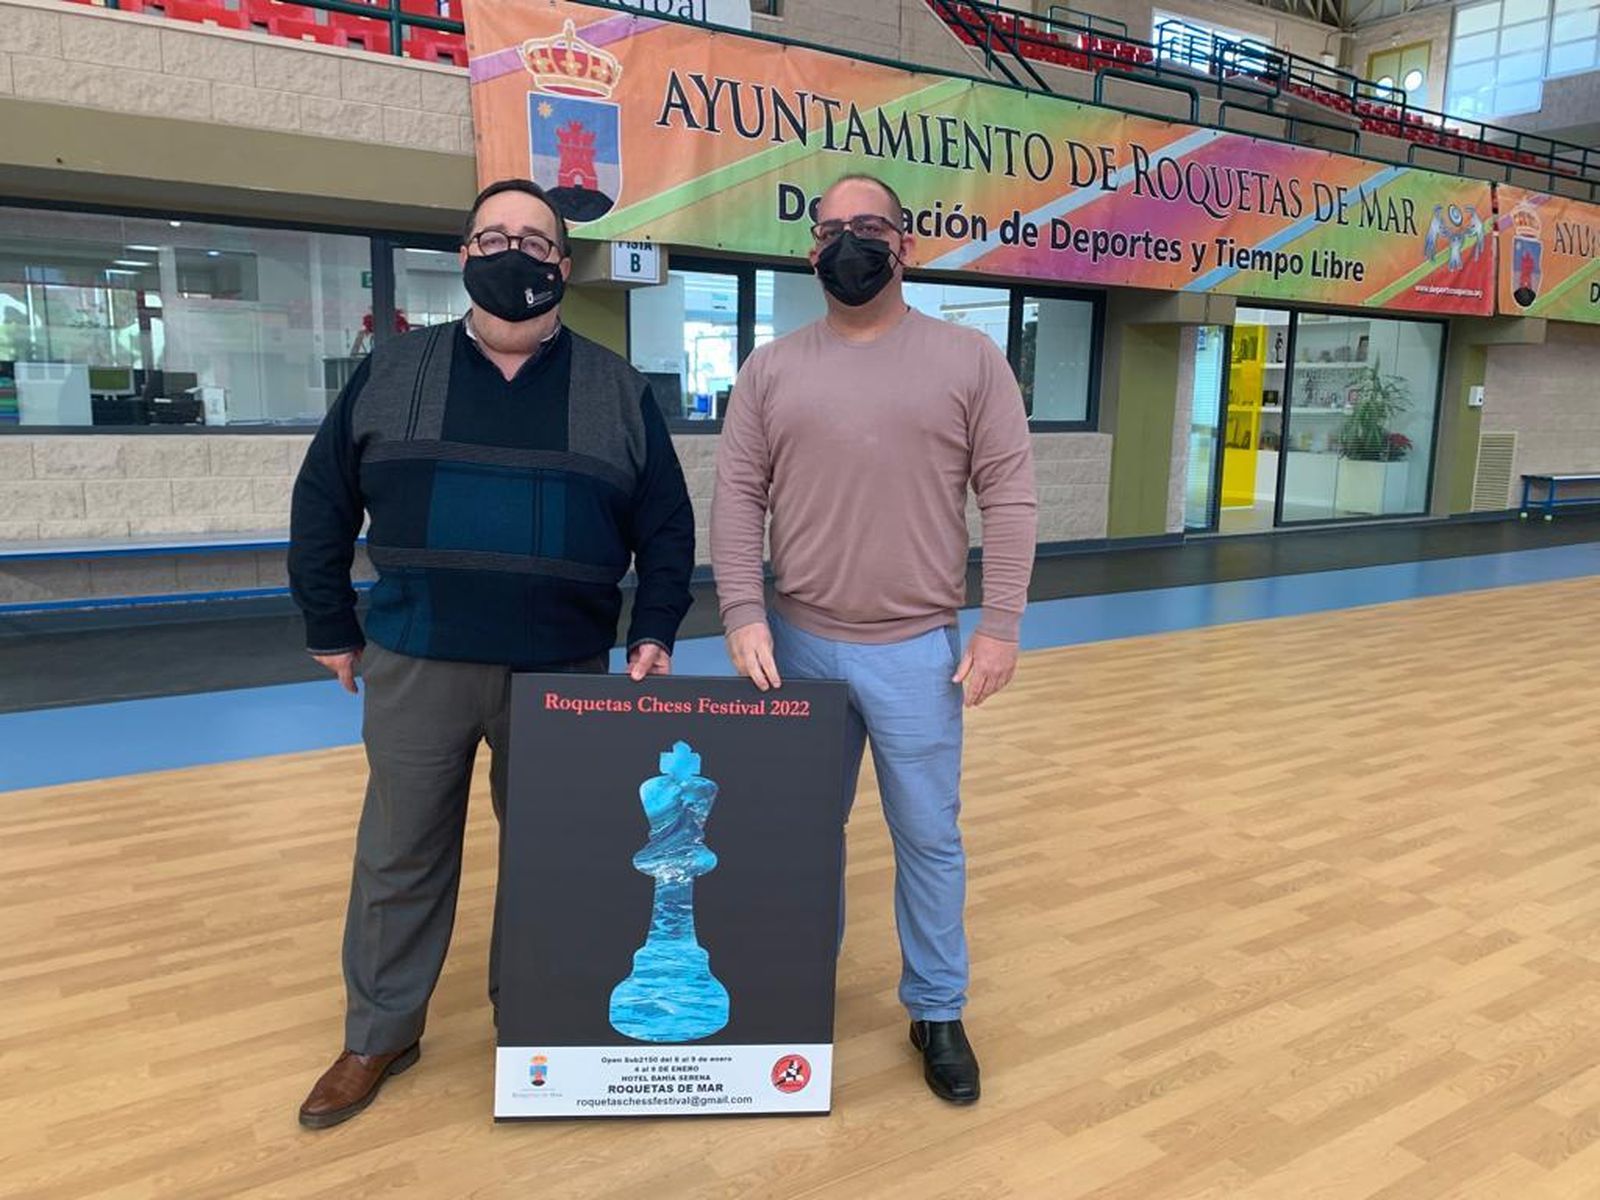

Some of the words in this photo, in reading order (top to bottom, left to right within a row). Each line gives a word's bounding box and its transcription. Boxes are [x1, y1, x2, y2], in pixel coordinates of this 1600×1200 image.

[656, 70, 1054, 182] AYUNTAMIENTO
[1065, 140, 1118, 191] DE
[1129, 143, 1304, 219] ROQUETAS
[1312, 182, 1349, 226] DE
[1358, 183, 1418, 236] MAR
[778, 183, 988, 242] Dación
[999, 210, 1039, 248] de
[1050, 217, 1183, 263] Deportes
[1191, 242, 1207, 273] y
[1215, 238, 1304, 280] Tiempo
[1311, 250, 1365, 282] Libre
[630, 253, 642, 273] B
[544, 693, 632, 715] Roquetas
[637, 696, 692, 713] Chess
[697, 697, 766, 715] Festival
[770, 700, 811, 716] 2022
[601, 1056, 622, 1064] Open
[608, 1084, 674, 1094] ROQUETAS
[677, 1084, 693, 1093] DE
[696, 1083, 724, 1092] MAR
[576, 1095, 753, 1108] roquetaschessfestival@gmail.com
